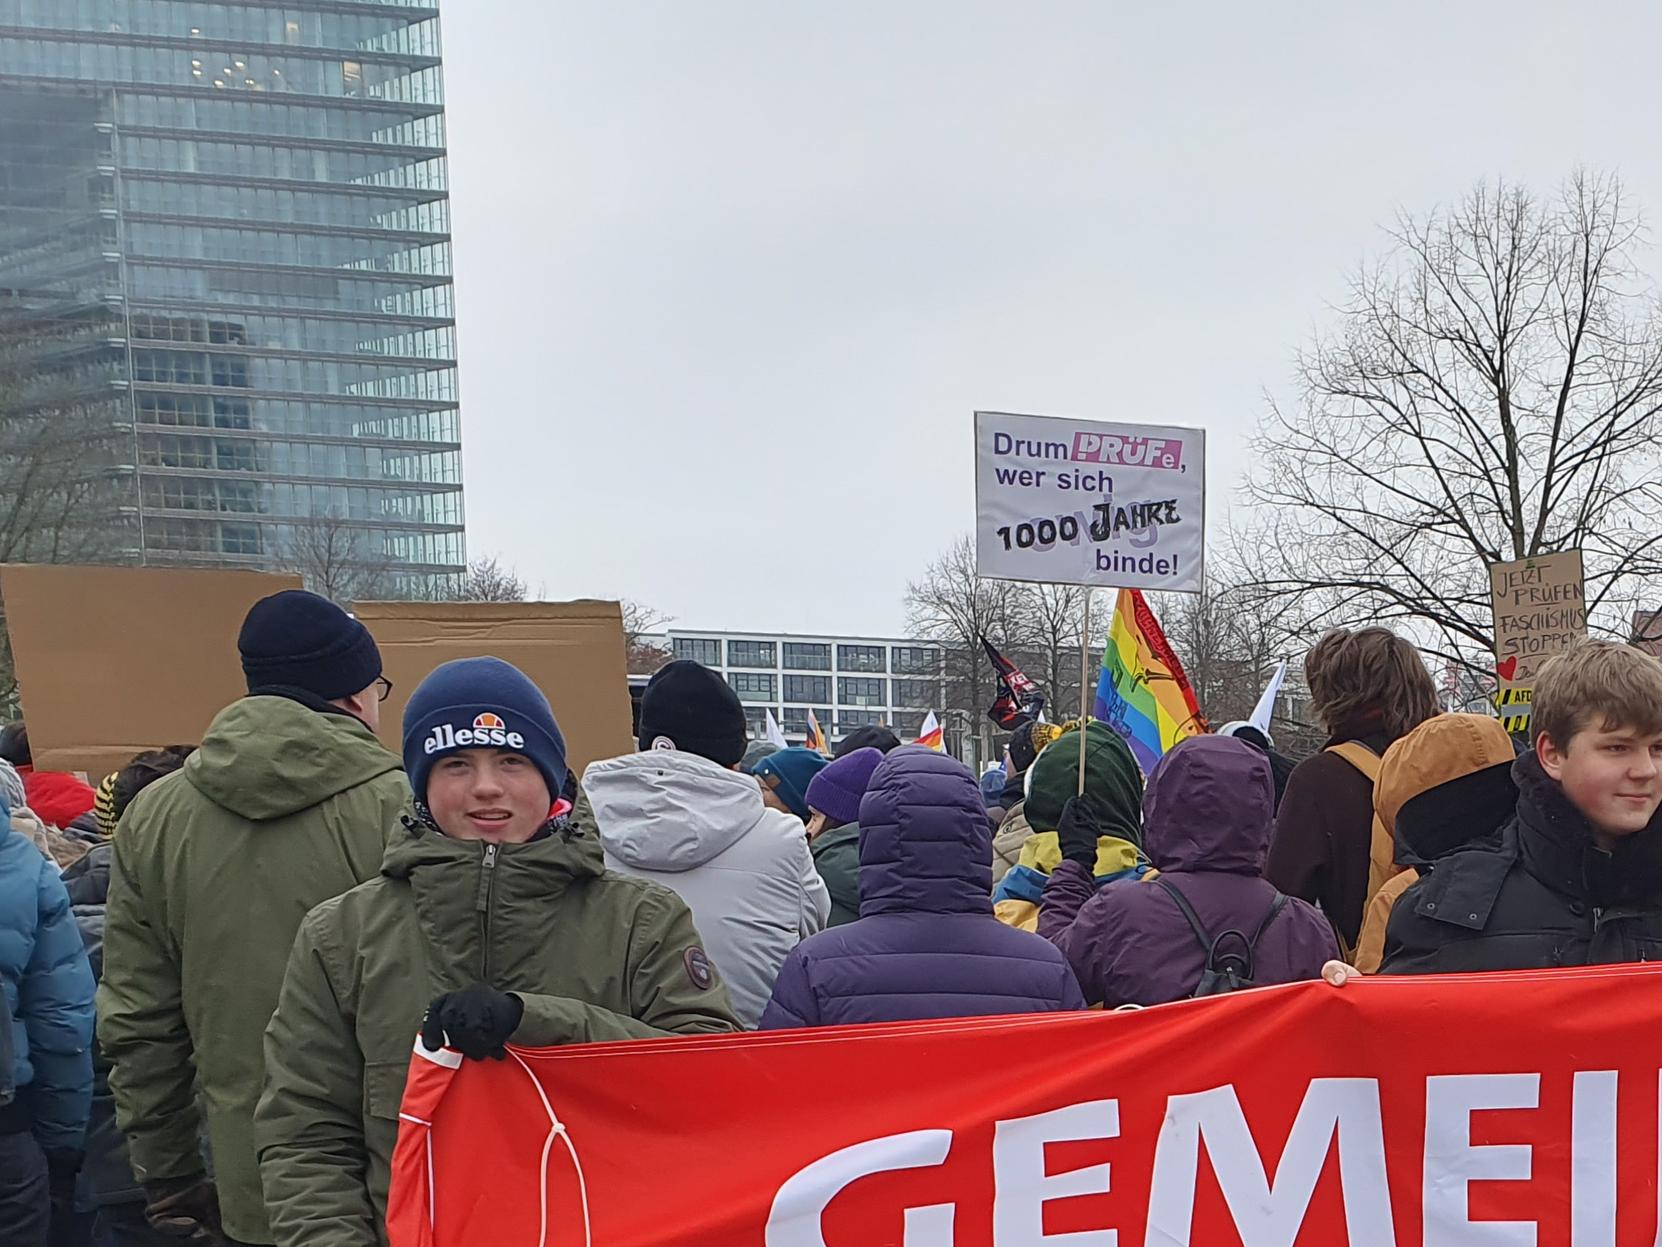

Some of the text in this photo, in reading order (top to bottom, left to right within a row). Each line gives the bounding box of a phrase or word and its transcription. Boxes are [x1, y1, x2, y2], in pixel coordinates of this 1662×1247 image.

[994, 431, 1068, 461] Drum
[995, 467, 1113, 493] wer sich
[997, 498, 1182, 551] 1000 JAHRE
[1095, 548, 1178, 576] binde!
[1497, 564, 1552, 598] JETZT
[1513, 578, 1583, 606] PRÜFEN
[1499, 606, 1584, 634] FASCHISMUS
[423, 723, 525, 754] ellesse
